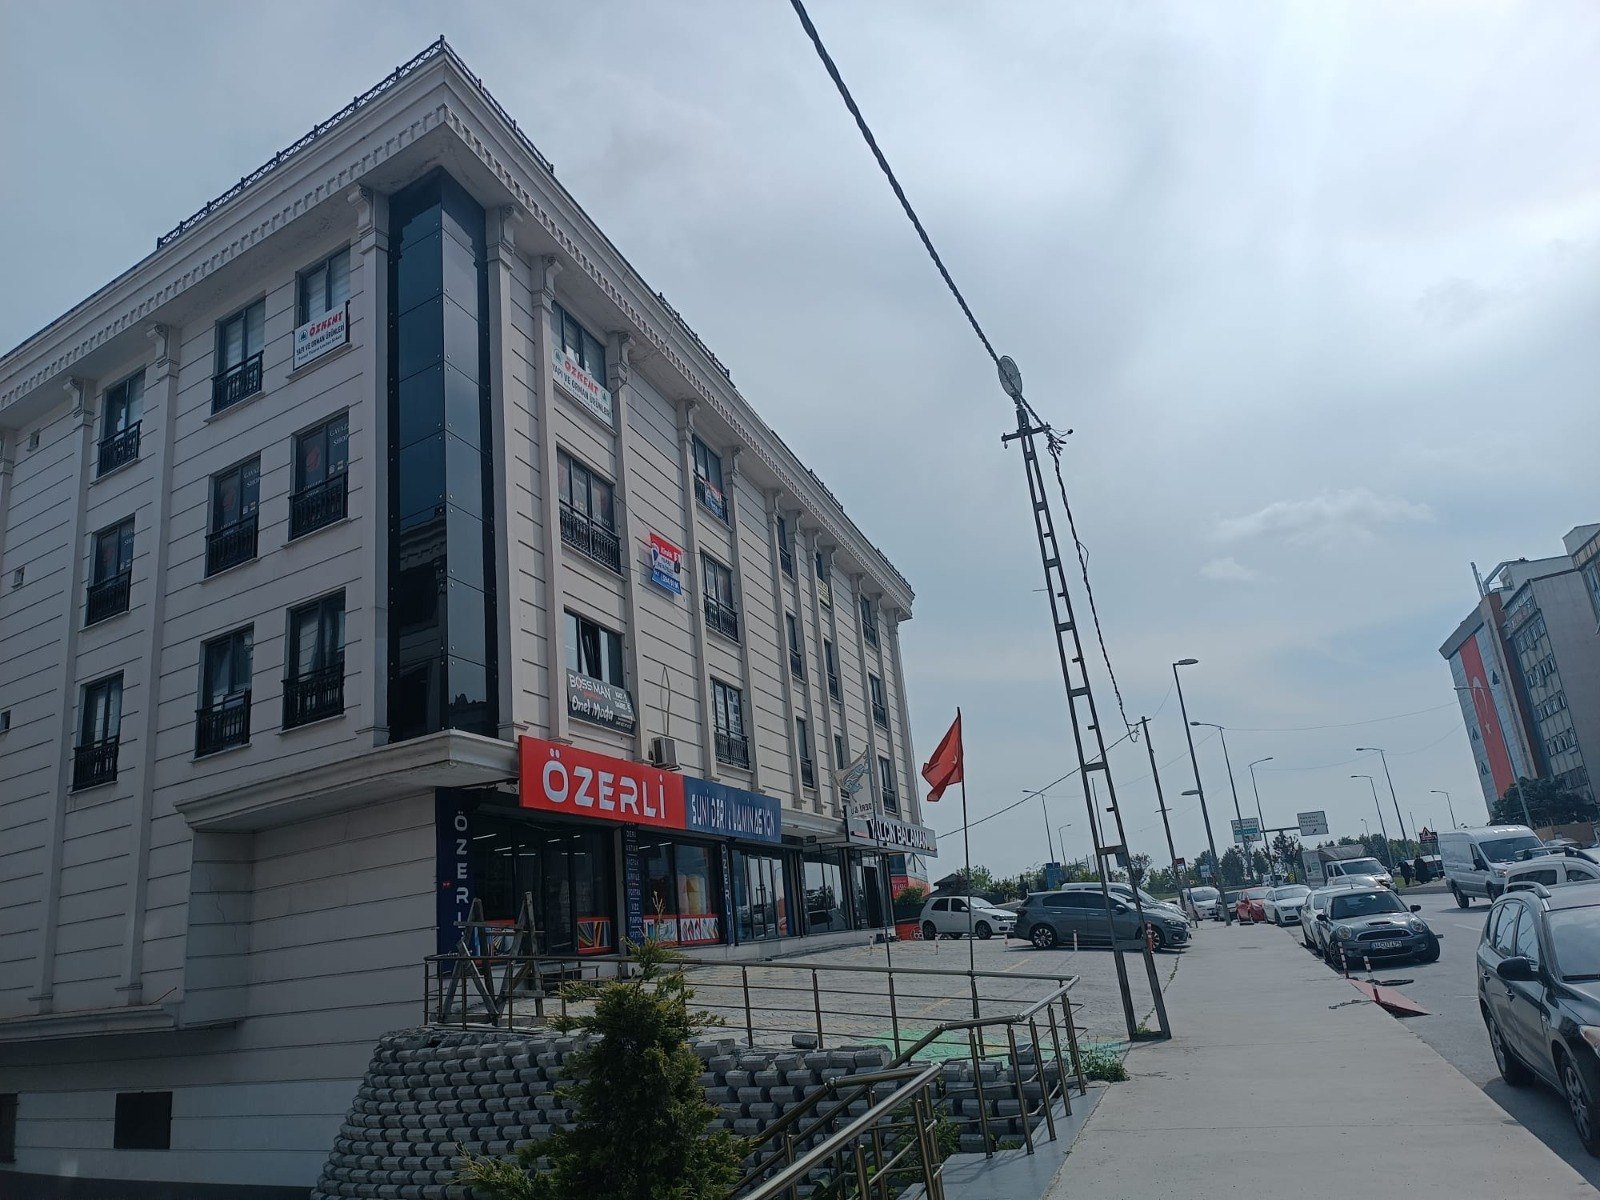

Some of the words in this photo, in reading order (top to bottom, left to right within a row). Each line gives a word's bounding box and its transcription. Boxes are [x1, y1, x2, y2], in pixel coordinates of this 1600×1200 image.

[542, 748, 666, 819] ÖZERLİ
[691, 788, 710, 826] SUNİ
[711, 792, 727, 830] DERİ
[733, 798, 776, 837] LAMİNASYON
[897, 826, 928, 850] BALAMAN
